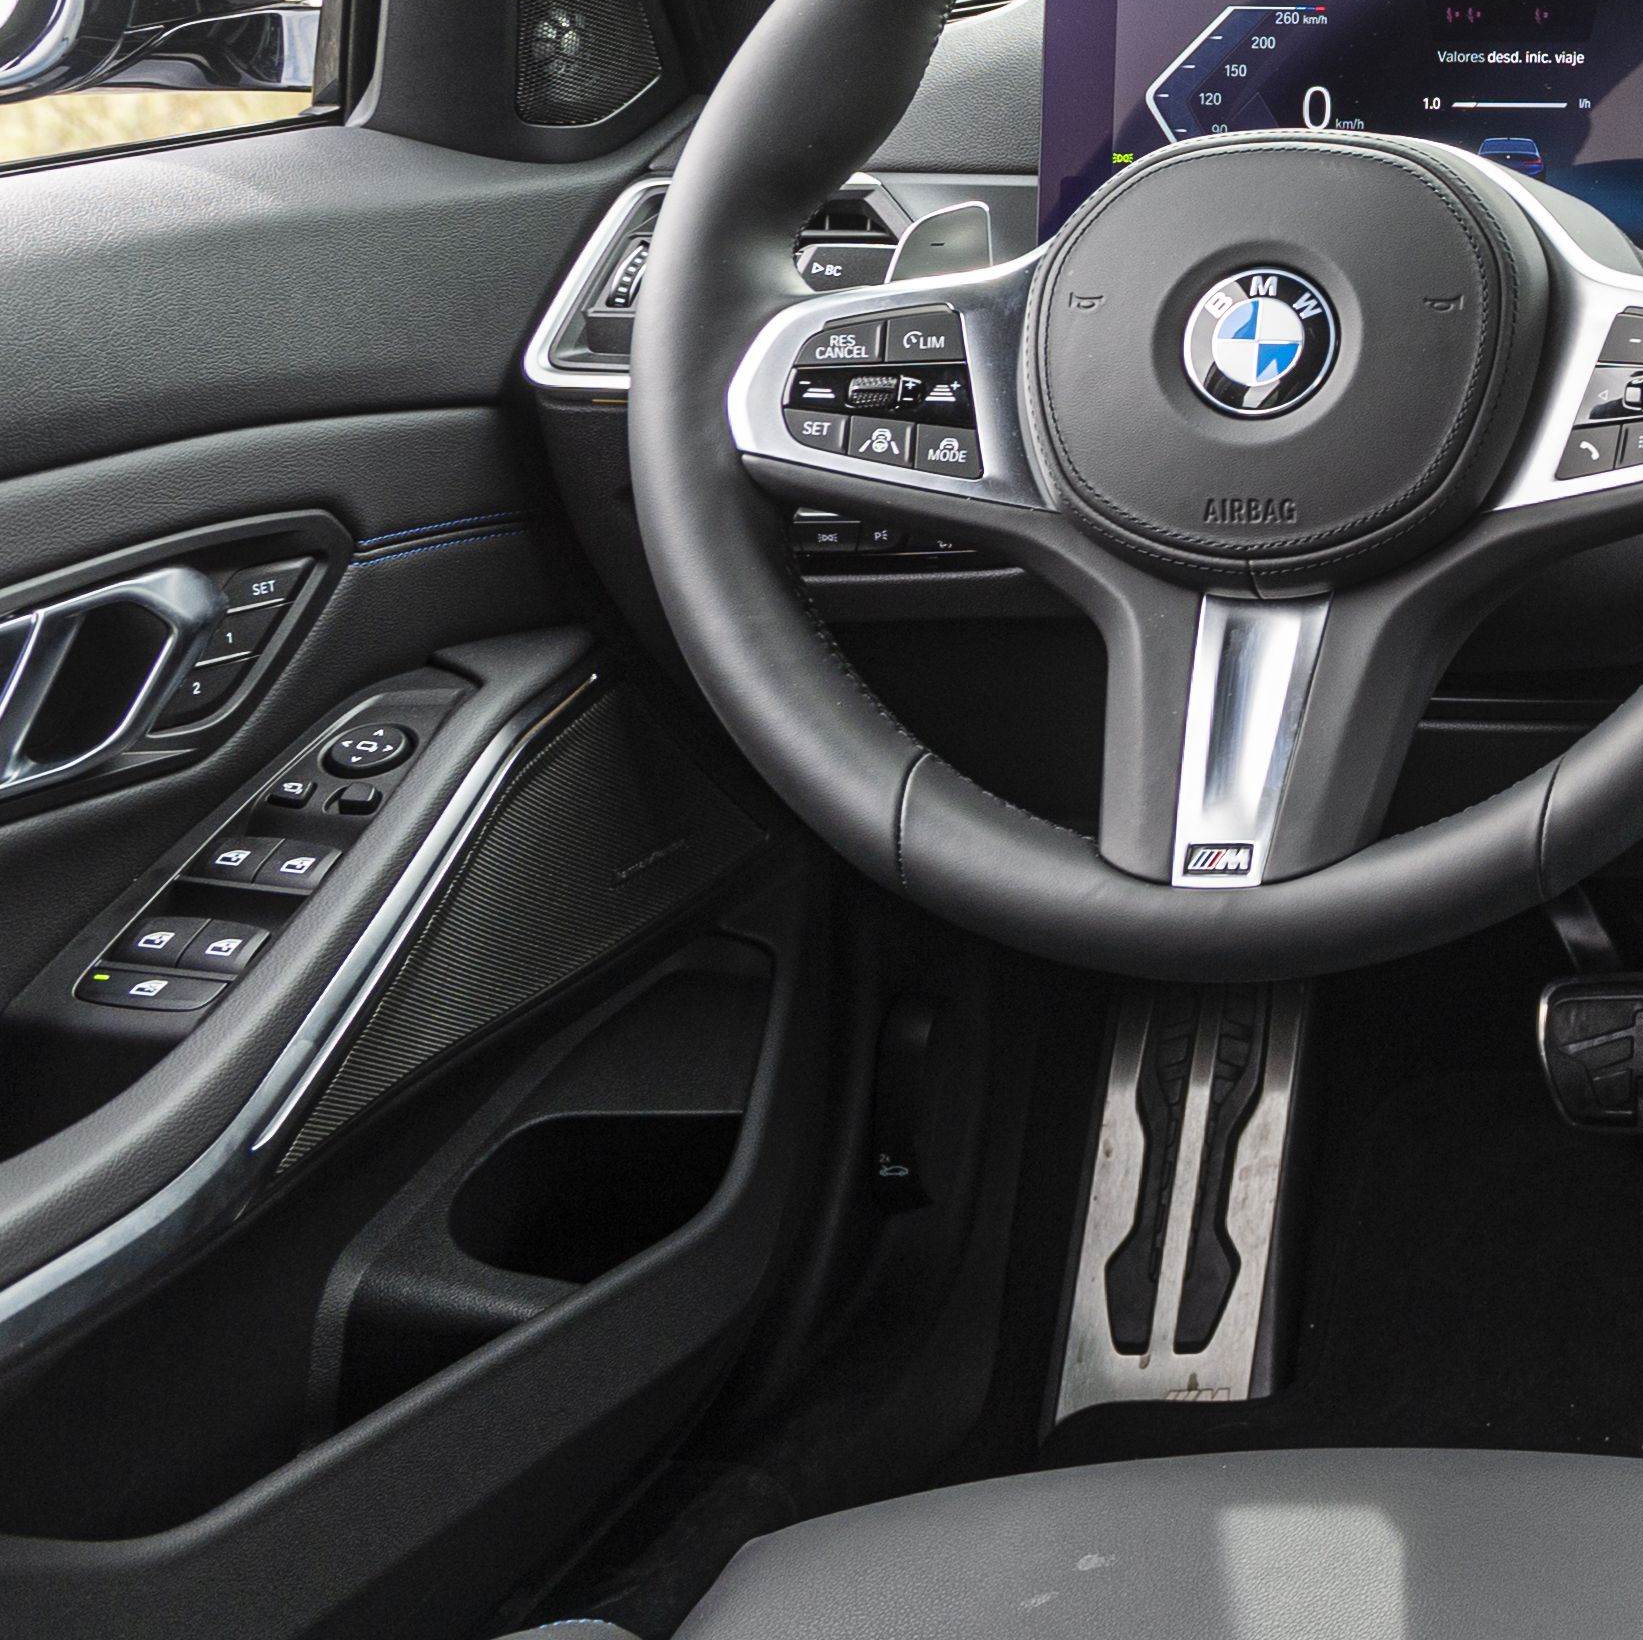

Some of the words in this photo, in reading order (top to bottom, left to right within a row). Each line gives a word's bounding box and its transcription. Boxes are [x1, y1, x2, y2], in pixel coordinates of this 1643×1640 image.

[1274, 11, 1300, 25] 260
[1302, 14, 1328, 25] km/h
[1250, 36, 1277, 49] 200
[1437, 50, 1486, 64] Valores
[1487, 50, 1522, 64] desd.
[1555, 50, 1585, 66] viaje
[1224, 64, 1248, 78] 150
[1199, 92, 1222, 106] 120
[1422, 96, 1441, 110] 1.0
[1302, 85, 1333, 130] 0
[1335, 118, 1365, 130] km/h
[824, 264, 843, 277] BC
[1204, 275, 1323, 319] BMW
[829, 334, 856, 347] RES
[919, 335, 945, 350] LIM
[815, 345, 869, 359] CANCEL
[802, 421, 831, 436] SET
[928, 448, 968, 462] MODE
[1203, 498, 1297, 525] AIRBAG
[252, 580, 275, 596] SET
[226, 632, 233, 644] 1
[192, 681, 201, 695] 2
[1213, 847, 1250, 871] M
